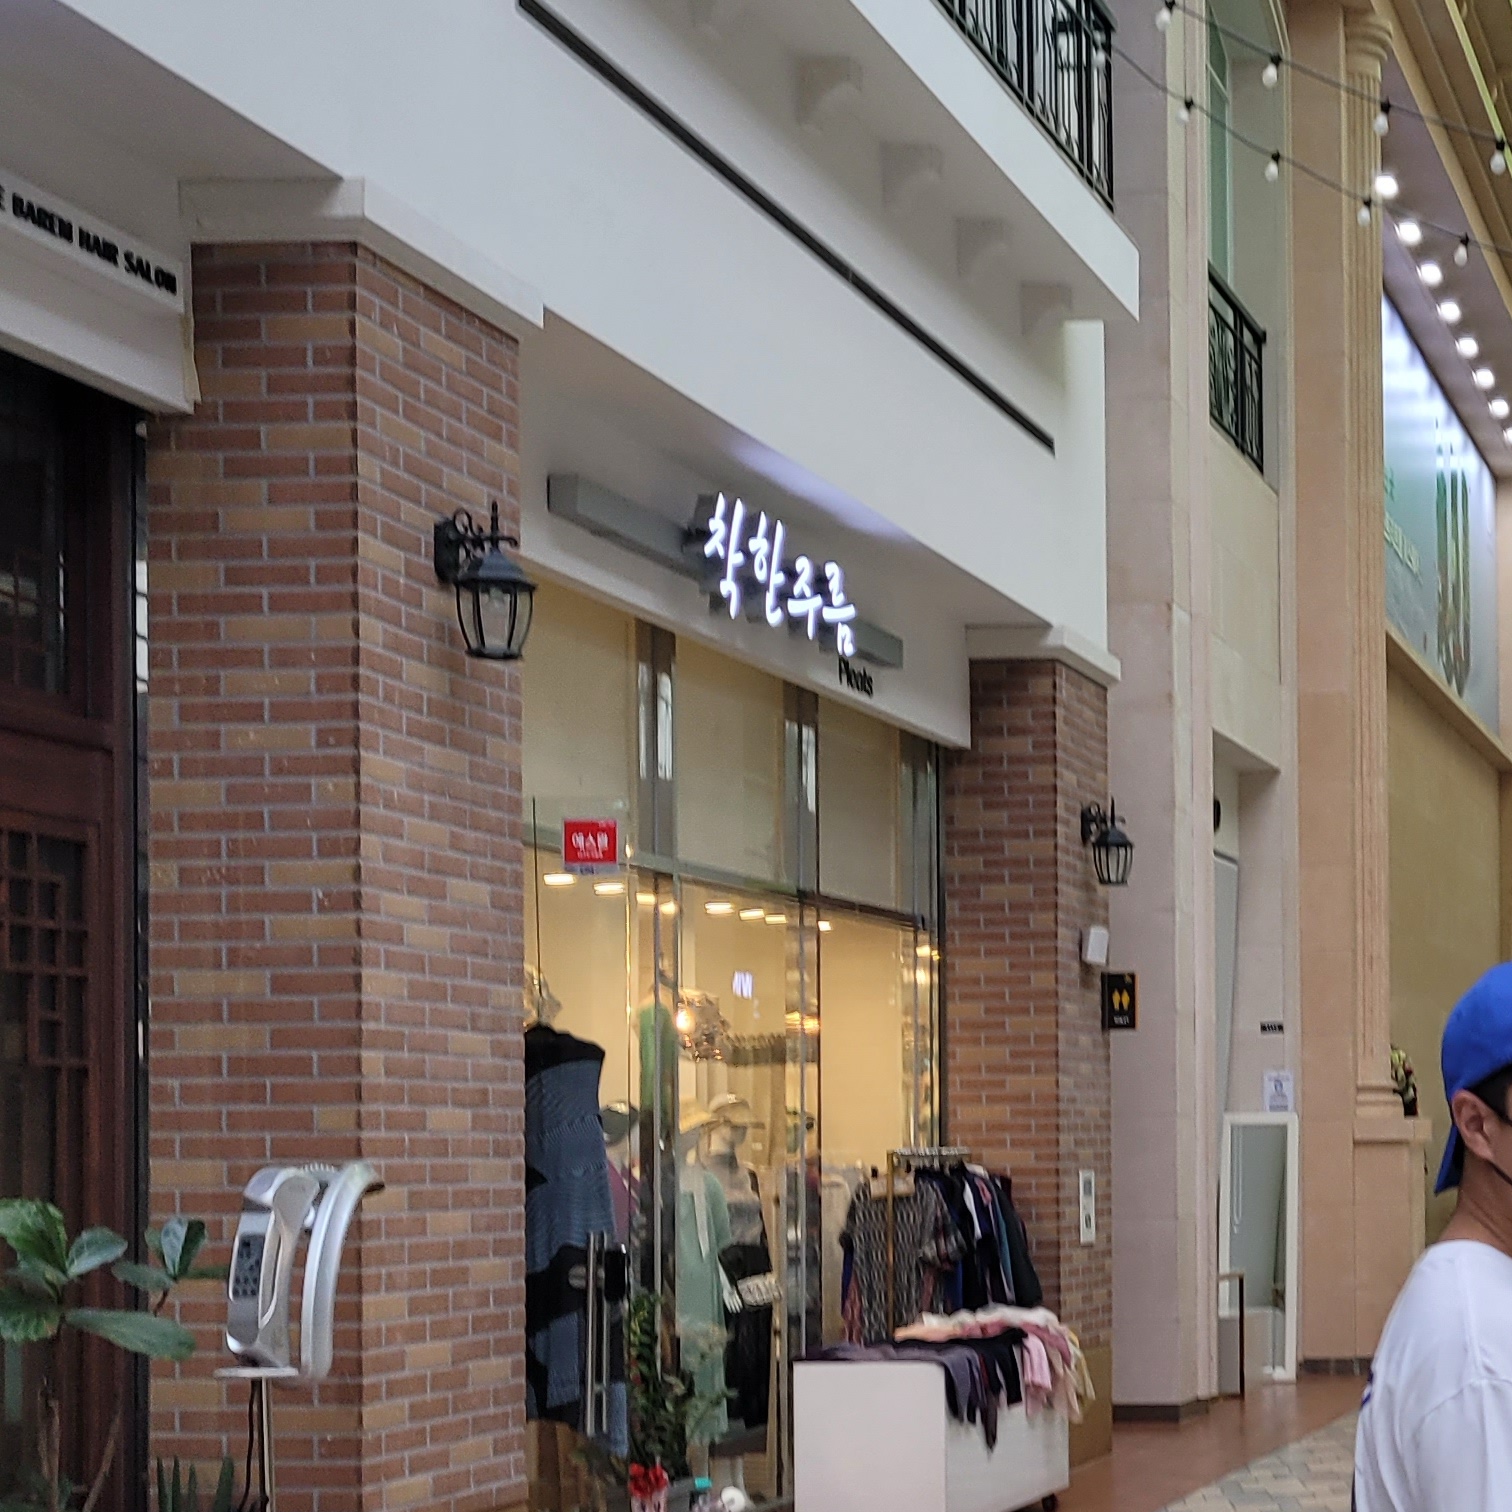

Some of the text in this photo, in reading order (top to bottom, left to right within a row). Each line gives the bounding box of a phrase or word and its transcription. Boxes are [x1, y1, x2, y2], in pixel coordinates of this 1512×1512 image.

[78, 226, 119, 268] HAIR
[123, 250, 177, 296] SALON
[704, 491, 857, 657] 착한주름
